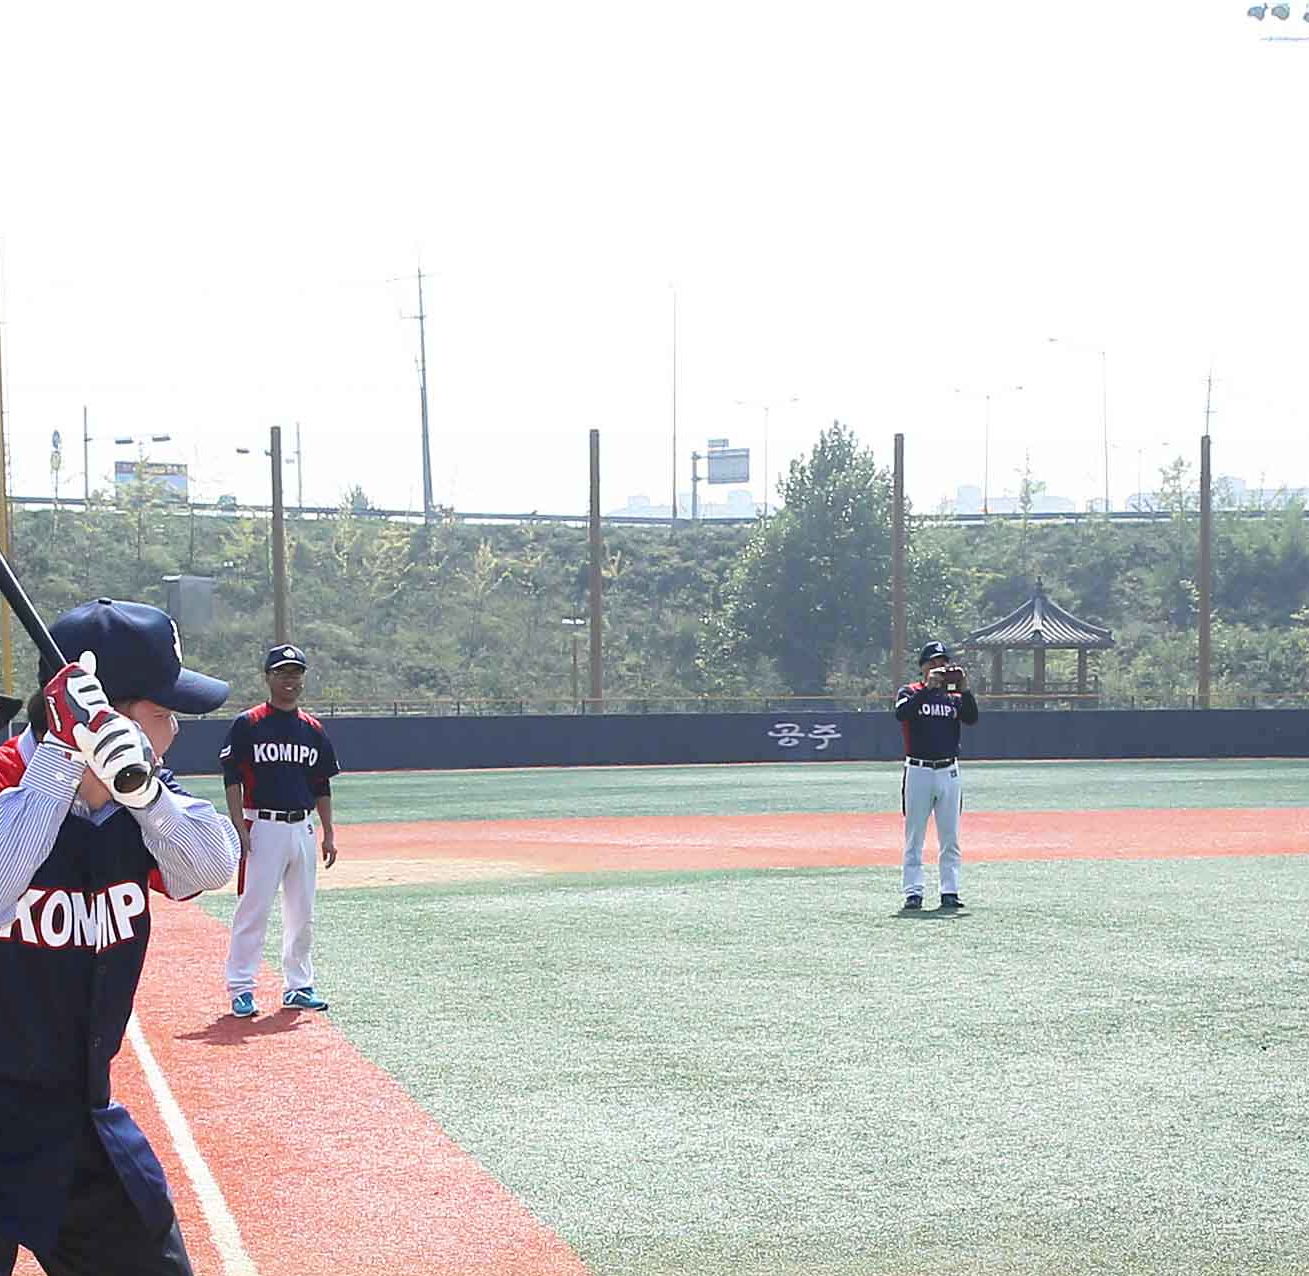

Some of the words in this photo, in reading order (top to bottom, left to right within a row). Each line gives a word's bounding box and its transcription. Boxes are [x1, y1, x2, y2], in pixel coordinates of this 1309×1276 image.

[917, 703, 958, 719] OMIP
[767, 723, 842, 750] 공주
[253, 743, 319, 767] KOMIPO
